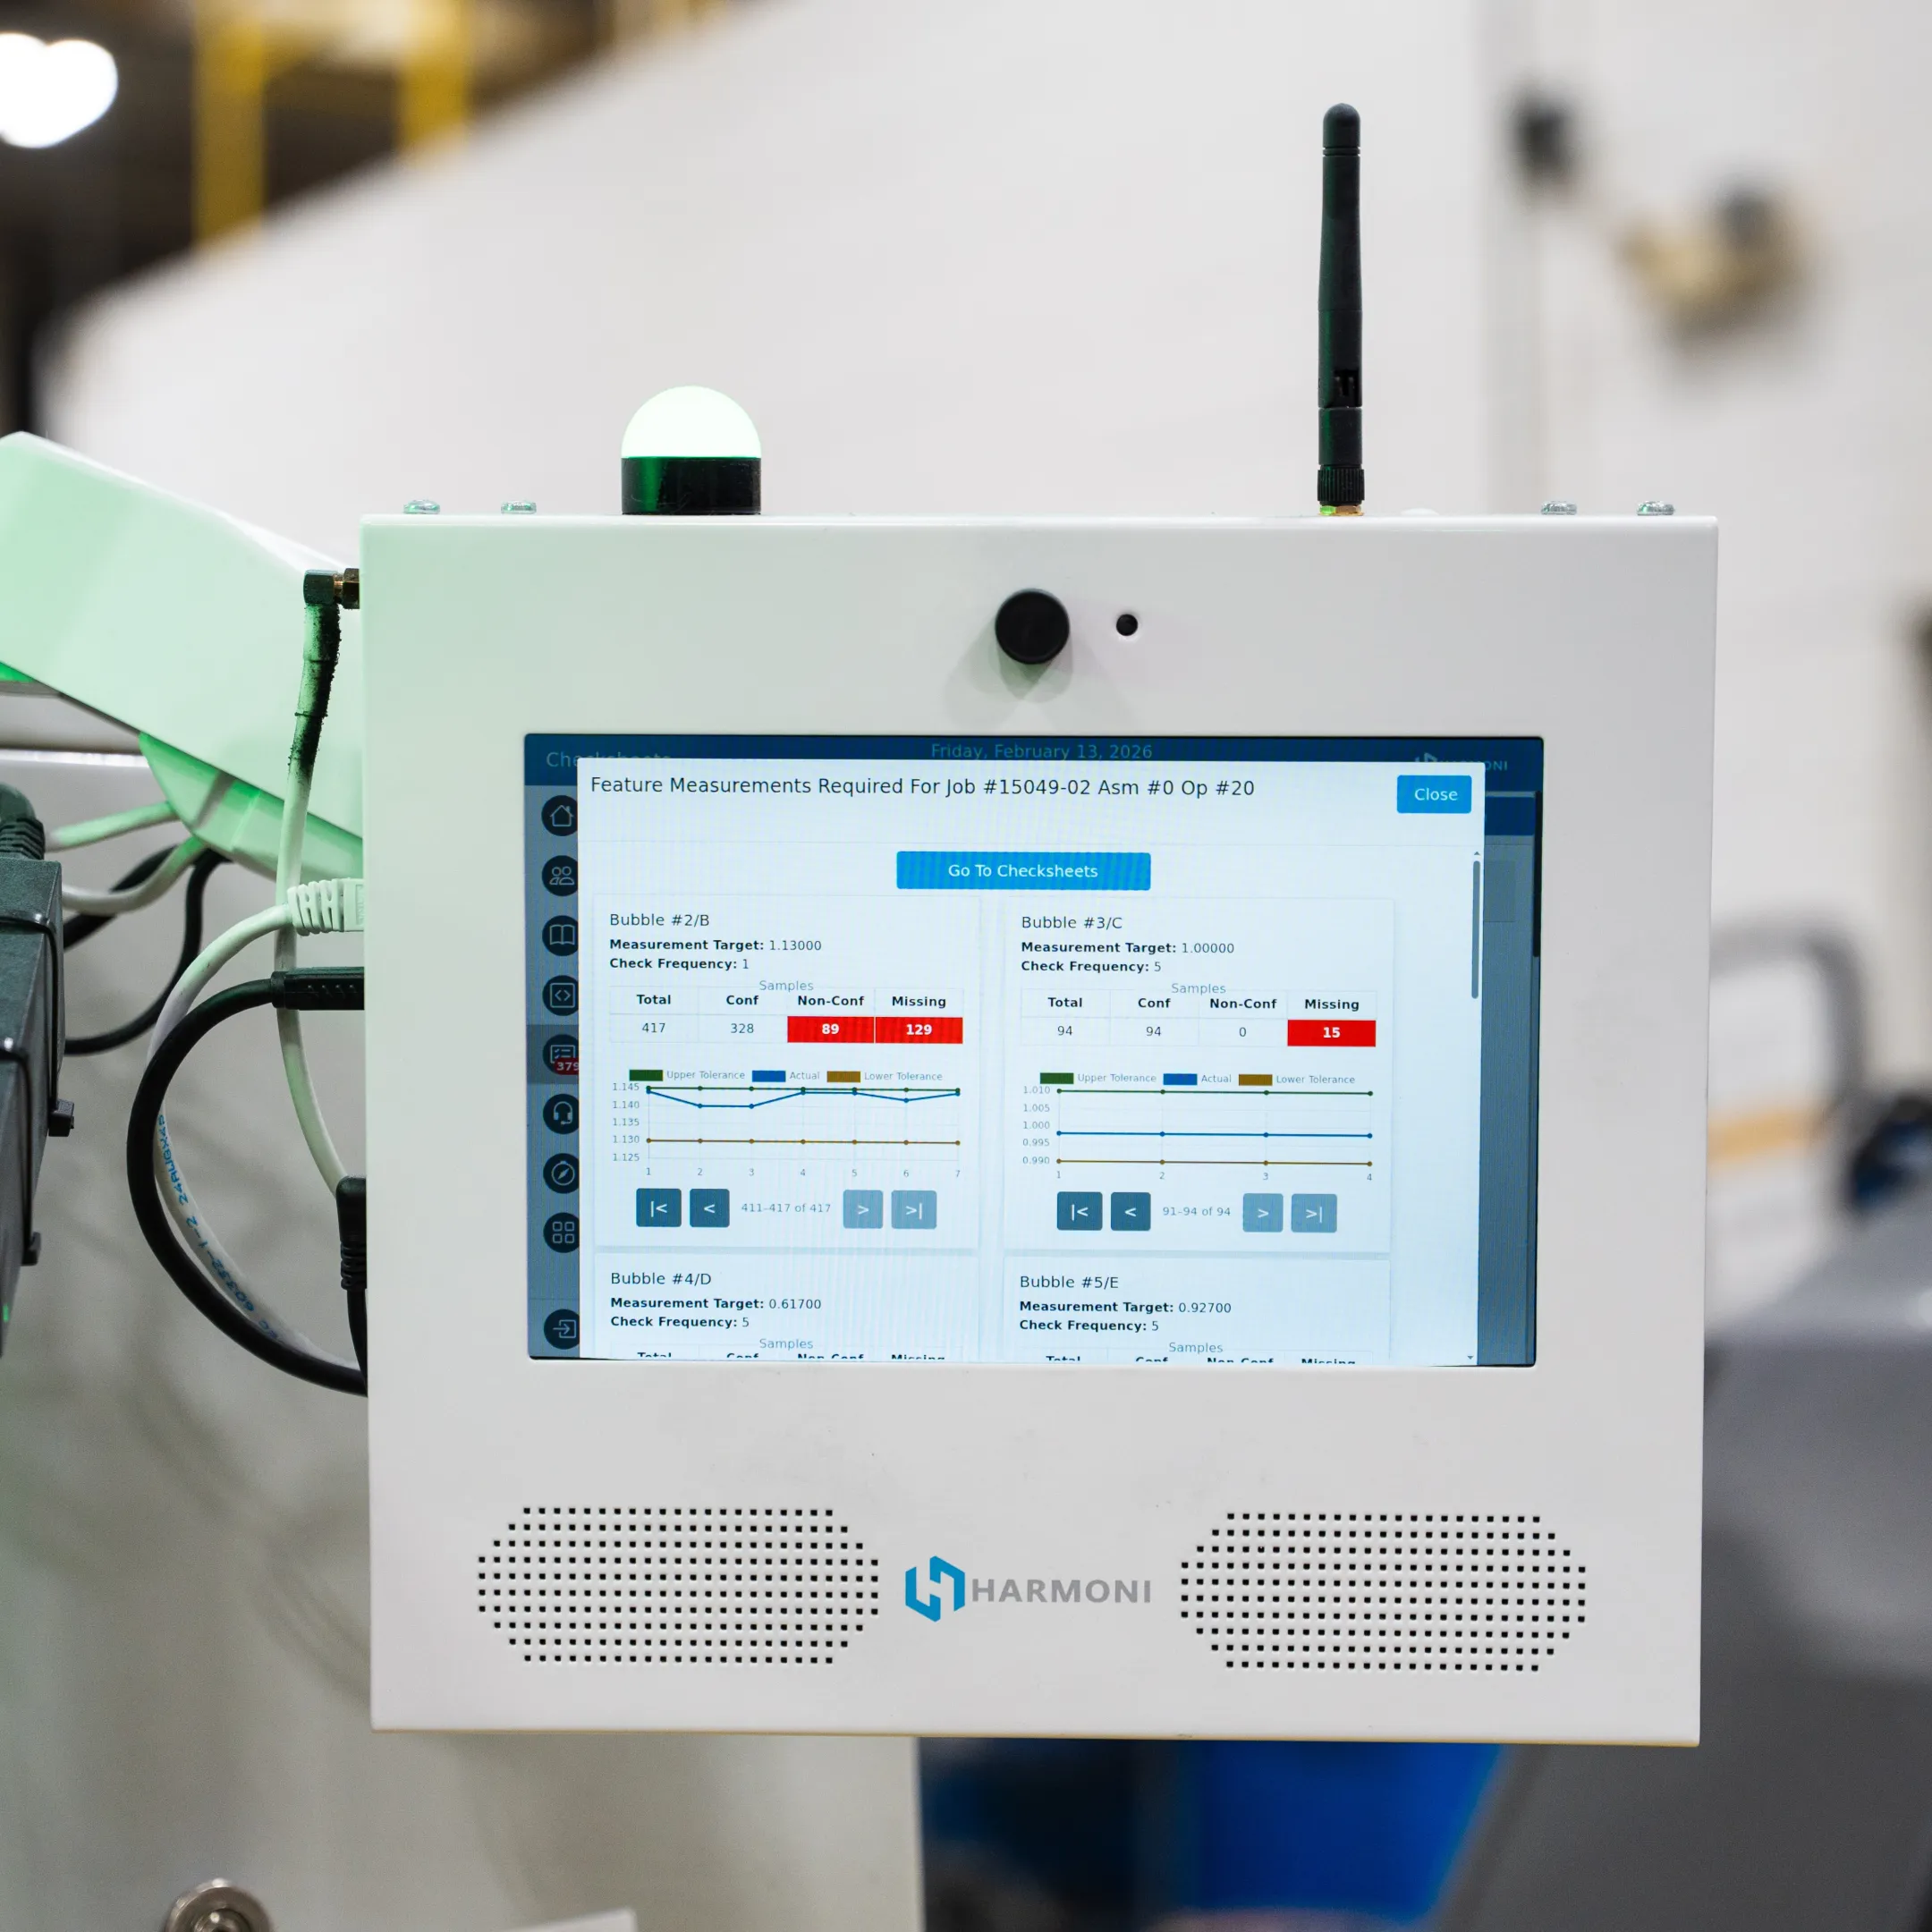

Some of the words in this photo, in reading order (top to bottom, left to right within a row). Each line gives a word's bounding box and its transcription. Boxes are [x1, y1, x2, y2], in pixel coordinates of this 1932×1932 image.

[931, 743, 987, 759] Friday,
[995, 743, 1070, 759] February
[1078, 744, 1102, 759] 13,
[1110, 744, 1152, 759] 2026
[592, 776, 663, 792] Feature
[671, 777, 811, 793] Measurements
[819, 777, 902, 797] Required
[911, 778, 940, 793] For
[945, 778, 975, 798] Job
[984, 779, 1089, 794] #15049-02
[1097, 780, 1139, 795] Asm
[1148, 780, 1174, 795] #0
[1182, 780, 1208, 799] Op
[1216, 780, 1254, 795] #20
[1414, 787, 1458, 801] Close
[948, 864, 970, 877] Go
[975, 864, 992, 877] To
[997, 864, 1098, 877] Checksheets
[610, 913, 665, 926] Bubble
[672, 914, 709, 928] #2/B
[1022, 916, 1076, 928] Bubble
[1084, 917, 1122, 930] #3/C
[610, 939, 708, 950] Measurement
[713, 940, 763, 953] Target:
[770, 940, 821, 951] 1.13000
[1021, 942, 1121, 953] Measurement
[1125, 943, 1175, 955] Target:
[1182, 943, 1234, 953] 1.00000
[610, 958, 652, 968] Check
[658, 958, 736, 971] Frequency:
[742, 959, 749, 969] 1
[1021, 961, 1063, 971] Check
[1070, 961, 1148, 974] Frequency:
[1154, 962, 1162, 971] 5
[759, 980, 814, 993] Samples
[1172, 983, 1226, 996] Samples
[636, 995, 671, 1004] Total
[726, 995, 758, 1005] Conf
[798, 996, 864, 1005] Non-Conf
[893, 996, 945, 1009] Missing
[1047, 997, 1082, 1007] Total
[1138, 998, 1171, 1008] Conf
[1210, 998, 1276, 1009] Non-Conf
[1305, 999, 1359, 1012] Missing
[642, 1022, 665, 1033] 417
[731, 1023, 754, 1034] 328
[822, 1023, 839, 1034] 89
[907, 1024, 932, 1035] 129
[1057, 1026, 1072, 1036] 94
[1147, 1026, 1161, 1036] 94
[1238, 1027, 1248, 1037] 0
[1324, 1027, 1340, 1038] 15
[666, 1071, 695, 1080] Upper
[699, 1071, 745, 1080] Tolerance
[789, 1072, 819, 1080] Actual
[864, 1072, 894, 1080] Lower
[896, 1072, 943, 1080] Tolerance
[1078, 1073, 1106, 1083] Upper
[1110, 1073, 1157, 1082] Tolerance
[1201, 1074, 1232, 1082] Actual
[1276, 1075, 1304, 1083] Lower
[1309, 1075, 1355, 1083] Tolerance
[613, 1082, 640, 1091] 1.145
[1024, 1086, 1050, 1094] 1.010
[613, 1101, 640, 1109] 1.140
[1024, 1104, 1050, 1112] 1.005
[614, 1118, 640, 1126] 1.135
[1023, 1121, 1050, 1129] 1.000
[614, 1135, 640, 1143] 1.130
[614, 1153, 640, 1161] 1.125
[646, 1167, 651, 1175] 1
[697, 1167, 704, 1176] 2
[749, 1168, 755, 1176] 3
[851, 1169, 858, 1177] 5
[1056, 1171, 1062, 1179] 1
[1158, 1172, 1165, 1180] 2
[794, 1203, 805, 1212] of
[809, 1204, 831, 1213] 417
[1201, 1207, 1213, 1216] of
[1216, 1208, 1231, 1216] 94
[612, 1272, 665, 1284] Bubble
[673, 1273, 711, 1286] #4/D
[1021, 1275, 1074, 1288] Bubble
[1081, 1276, 1118, 1290] #5/E
[611, 1298, 708, 1308] Measurement
[714, 1298, 763, 1310] Target:
[769, 1299, 821, 1309] 0.61700
[1020, 1301, 1118, 1311] Measurement
[1123, 1302, 1174, 1314] Target:
[1179, 1302, 1232, 1313] 0.92700
[611, 1316, 653, 1326] Check
[659, 1317, 737, 1329] Frequency:
[742, 1318, 750, 1326] 5
[1020, 1319, 1062, 1330] Check
[1068, 1320, 1146, 1333] Frequency:
[1151, 1321, 1159, 1331] 5
[759, 1338, 813, 1351] Samples
[1169, 1342, 1223, 1354] Samples
[972, 1579, 1150, 1603] HARMONI
